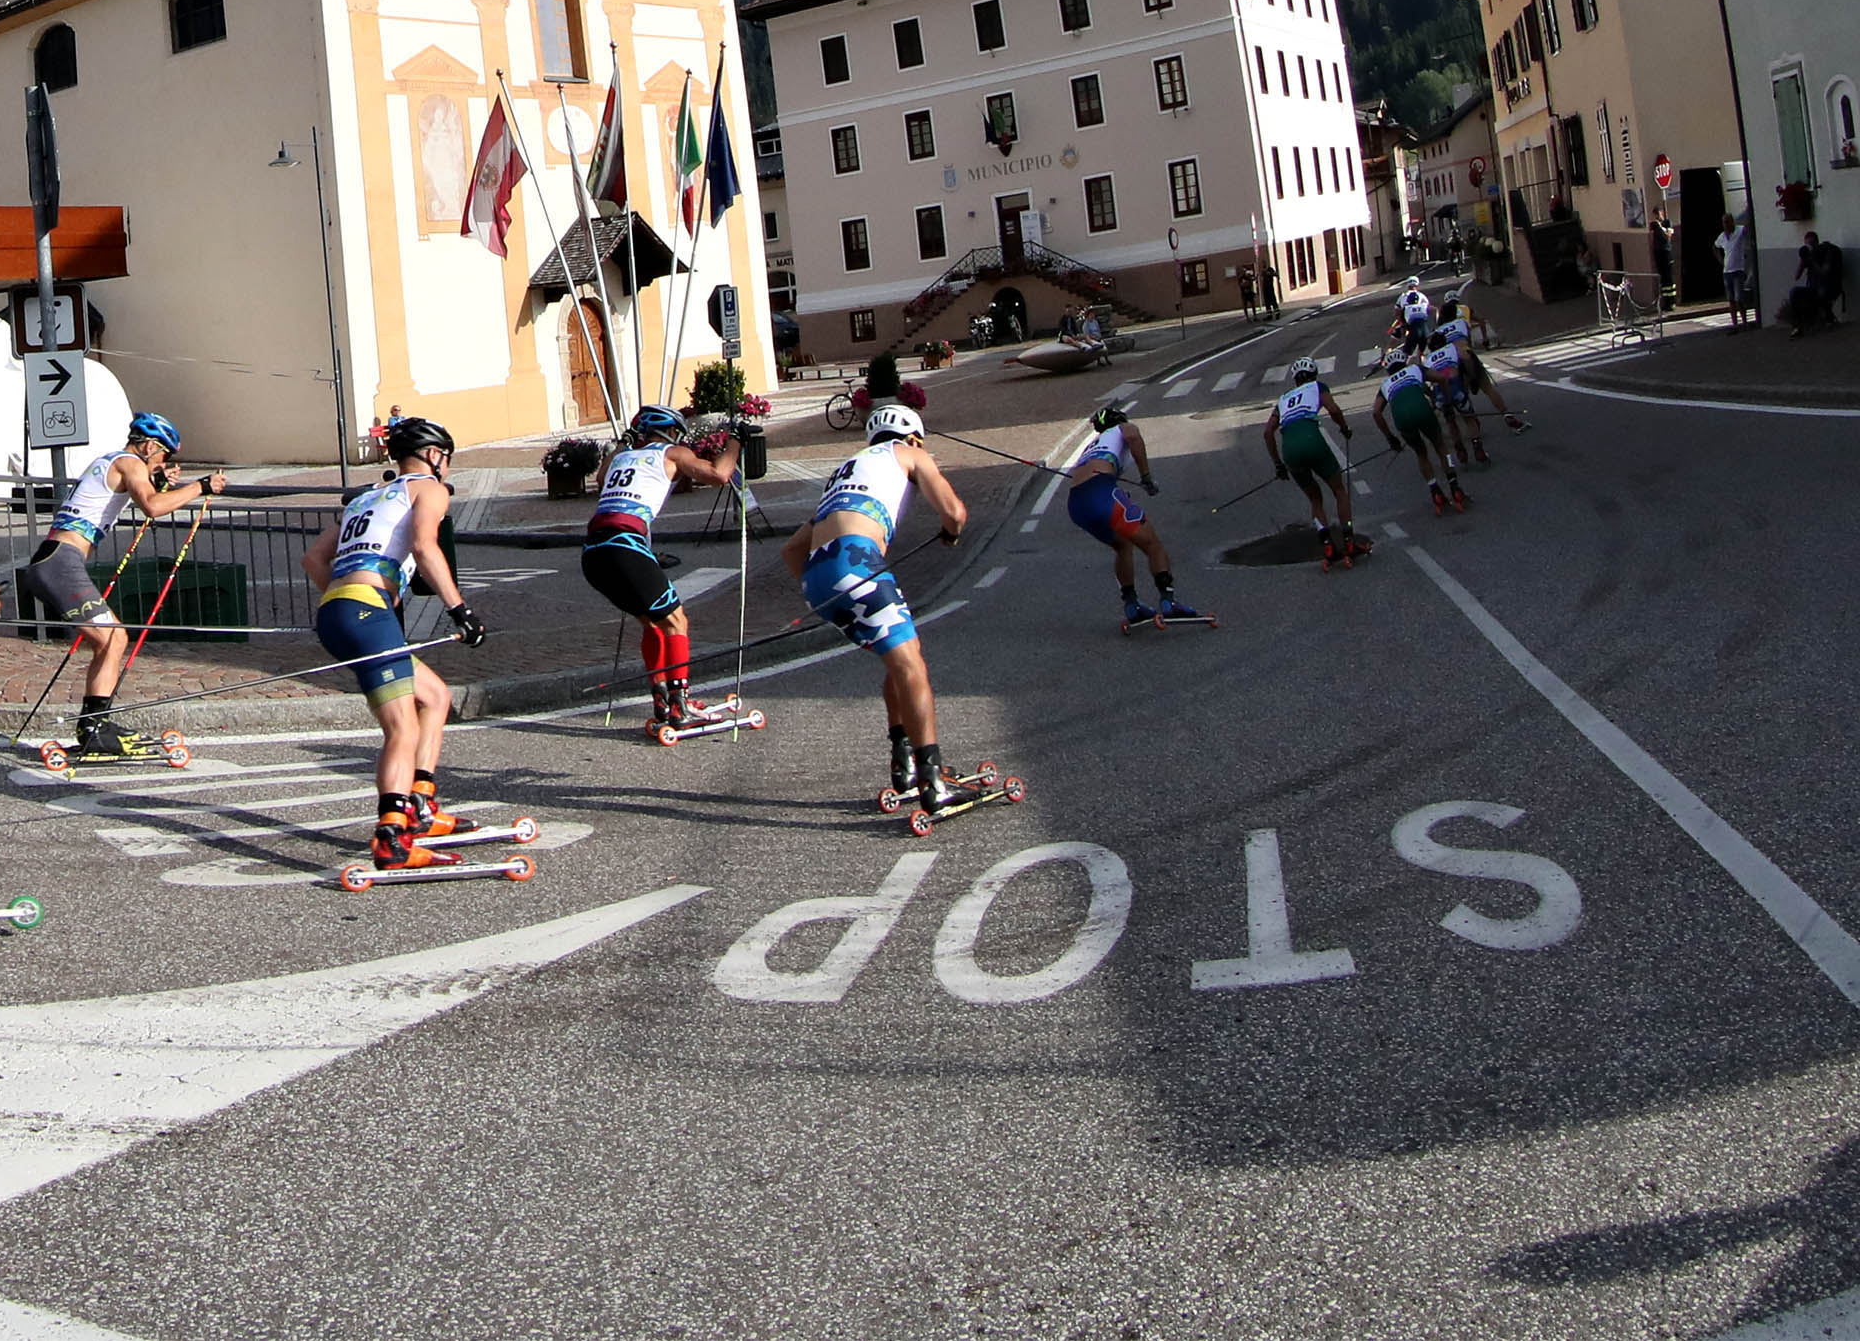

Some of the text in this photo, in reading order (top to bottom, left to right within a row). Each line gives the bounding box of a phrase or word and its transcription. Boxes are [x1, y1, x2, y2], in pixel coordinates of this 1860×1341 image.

[966, 154, 1053, 181] MUNICIPIO
[1655, 162, 1670, 179] STOP
[1287, 393, 1303, 408] 87
[606, 467, 636, 489] 93
[341, 509, 374, 544] 86
[712, 799, 1583, 1005] STOP
